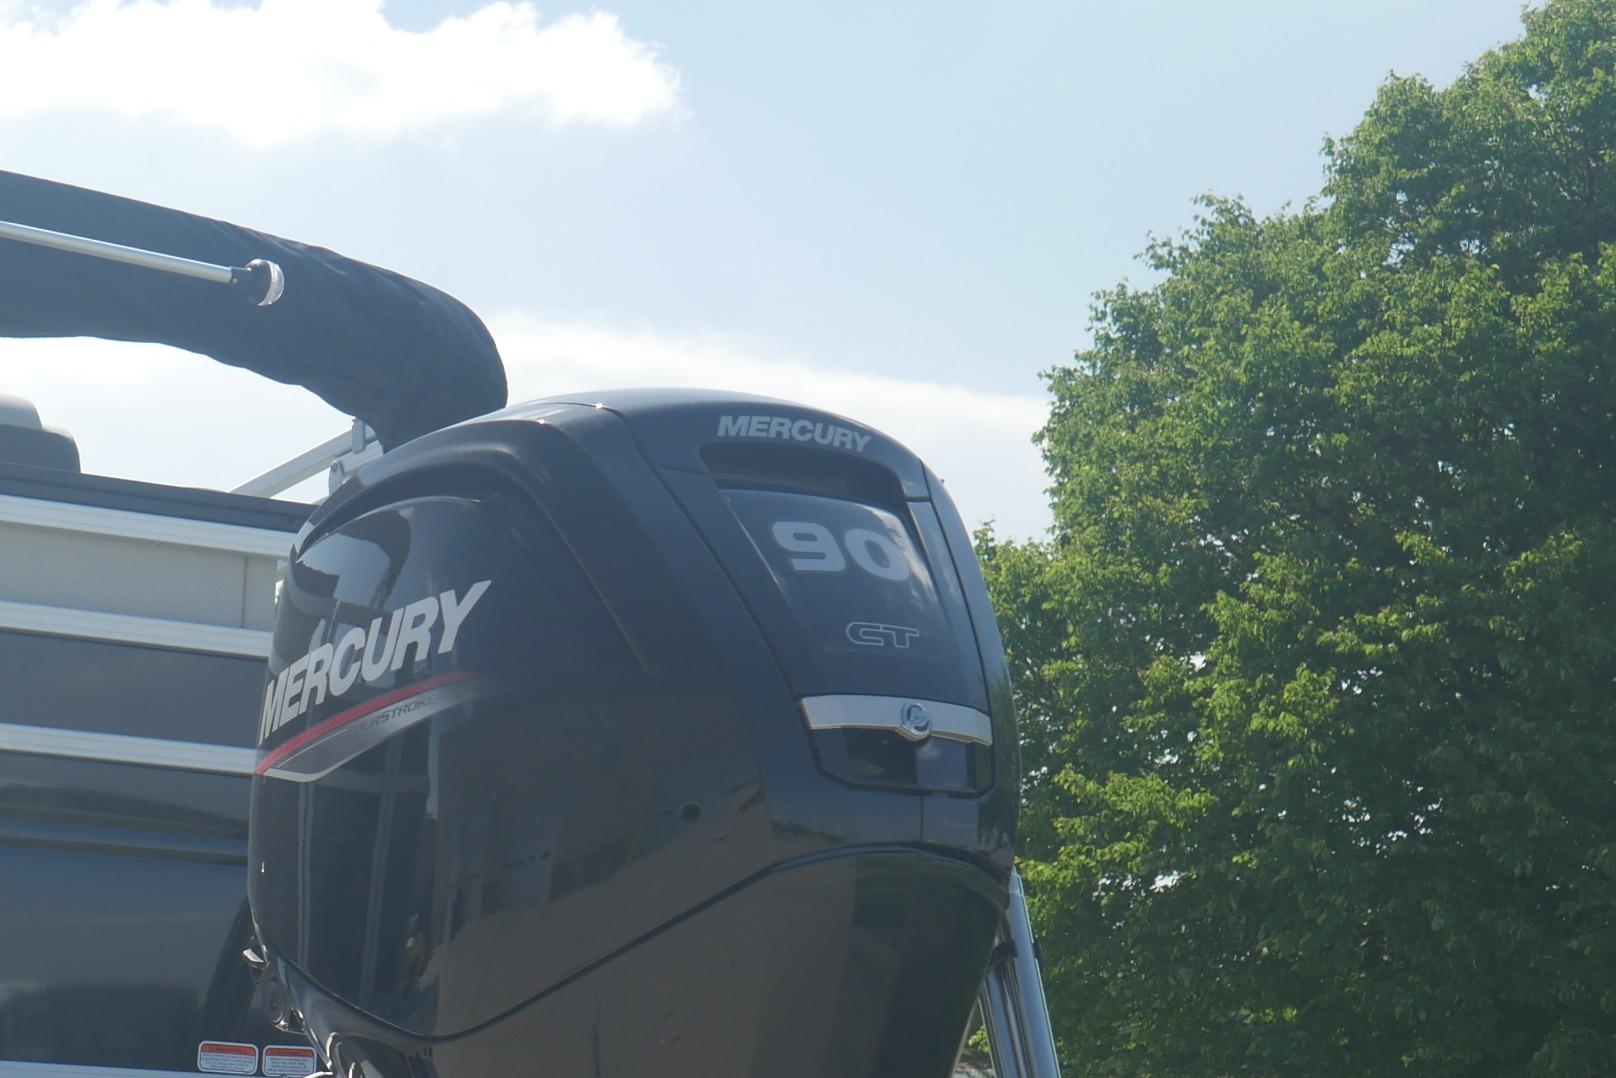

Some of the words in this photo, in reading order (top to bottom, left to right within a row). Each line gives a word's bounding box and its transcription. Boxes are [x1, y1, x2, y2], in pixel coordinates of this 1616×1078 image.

[717, 415, 873, 453] MERCURY
[771, 520, 911, 581] 90
[845, 621, 920, 649] CT
[258, 579, 492, 747] MERCURY
